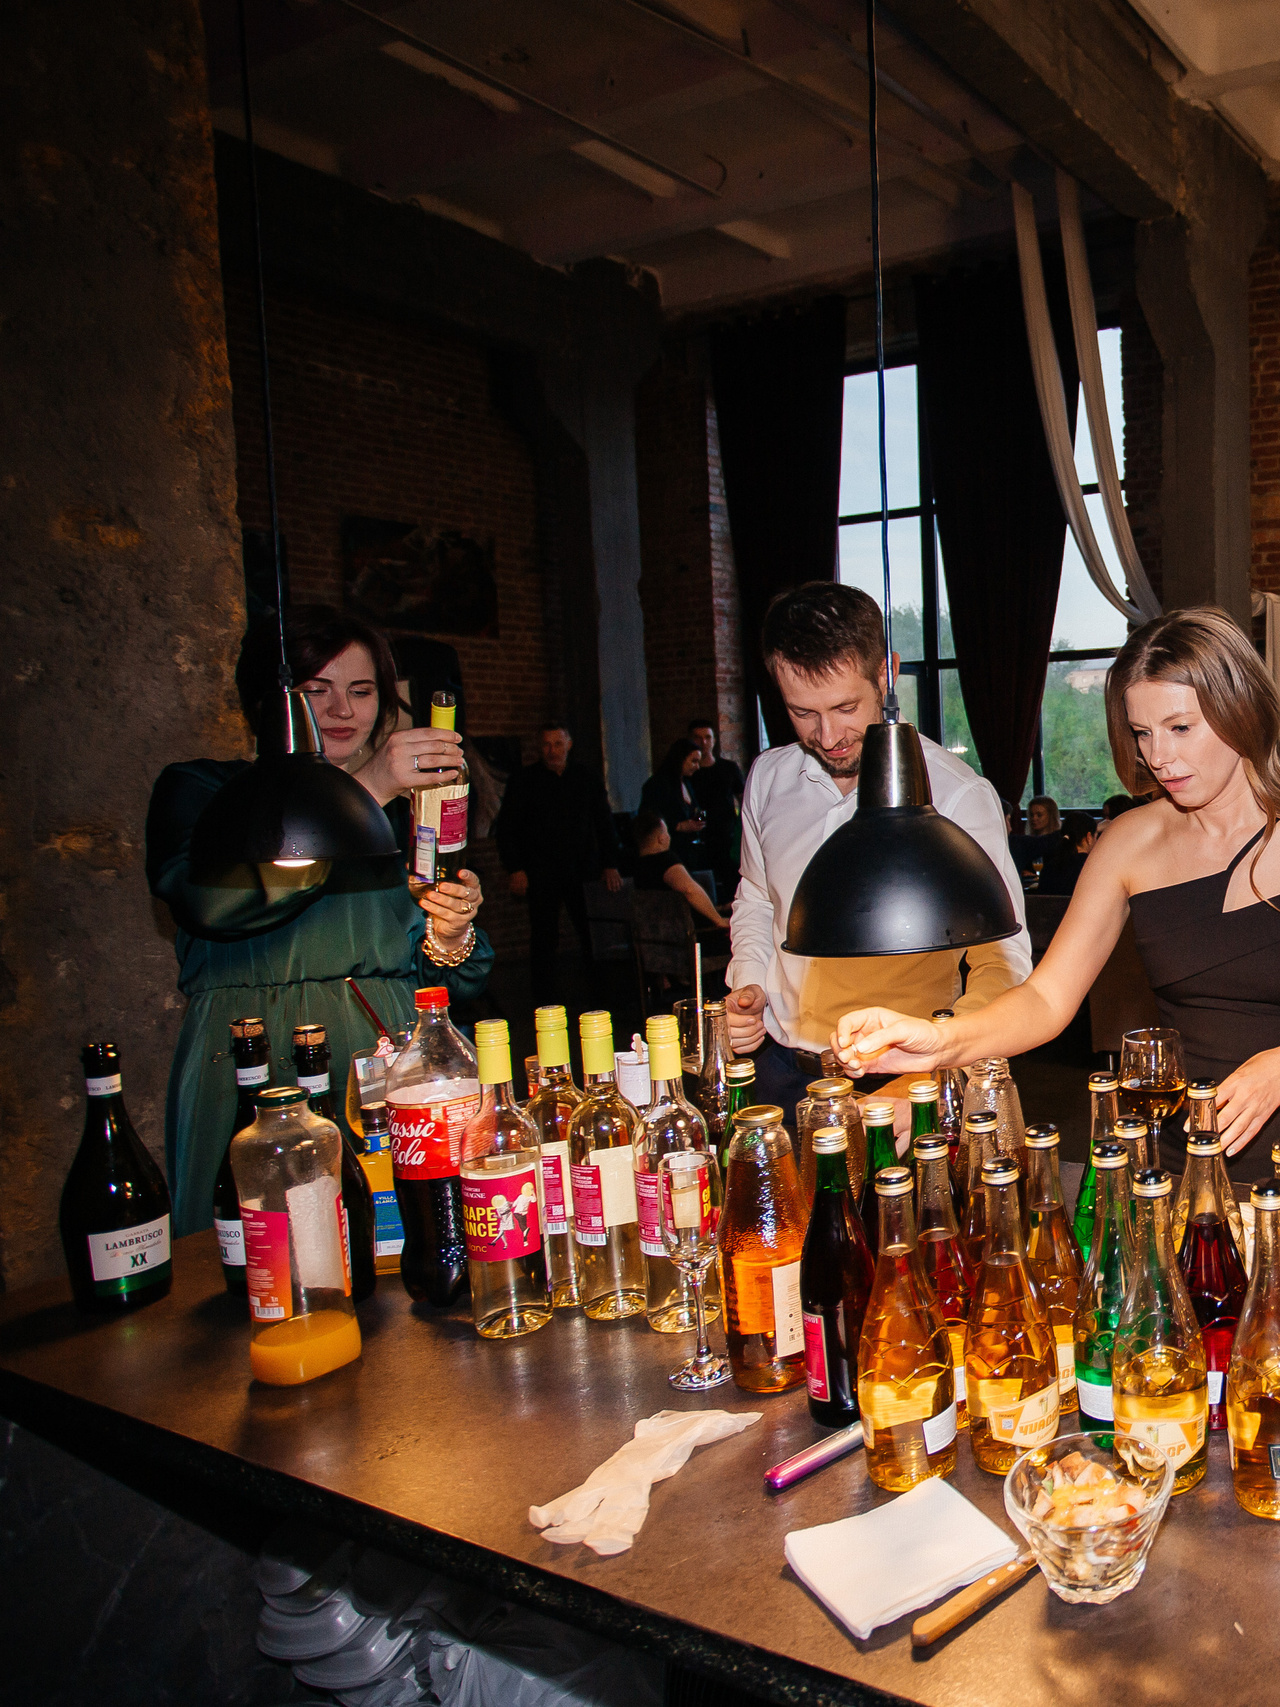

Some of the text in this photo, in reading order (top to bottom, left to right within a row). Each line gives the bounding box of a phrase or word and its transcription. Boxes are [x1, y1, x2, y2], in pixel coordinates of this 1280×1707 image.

[391, 1137, 427, 1166] Cola
[463, 1204, 498, 1222] RAPE
[218, 1230, 241, 1238] RUSCO
[465, 1220, 499, 1238] ANCE
[105, 1228, 164, 1251] LAMBRUSCO
[468, 1242, 488, 1253] lanc
[131, 1251, 148, 1268] XX
